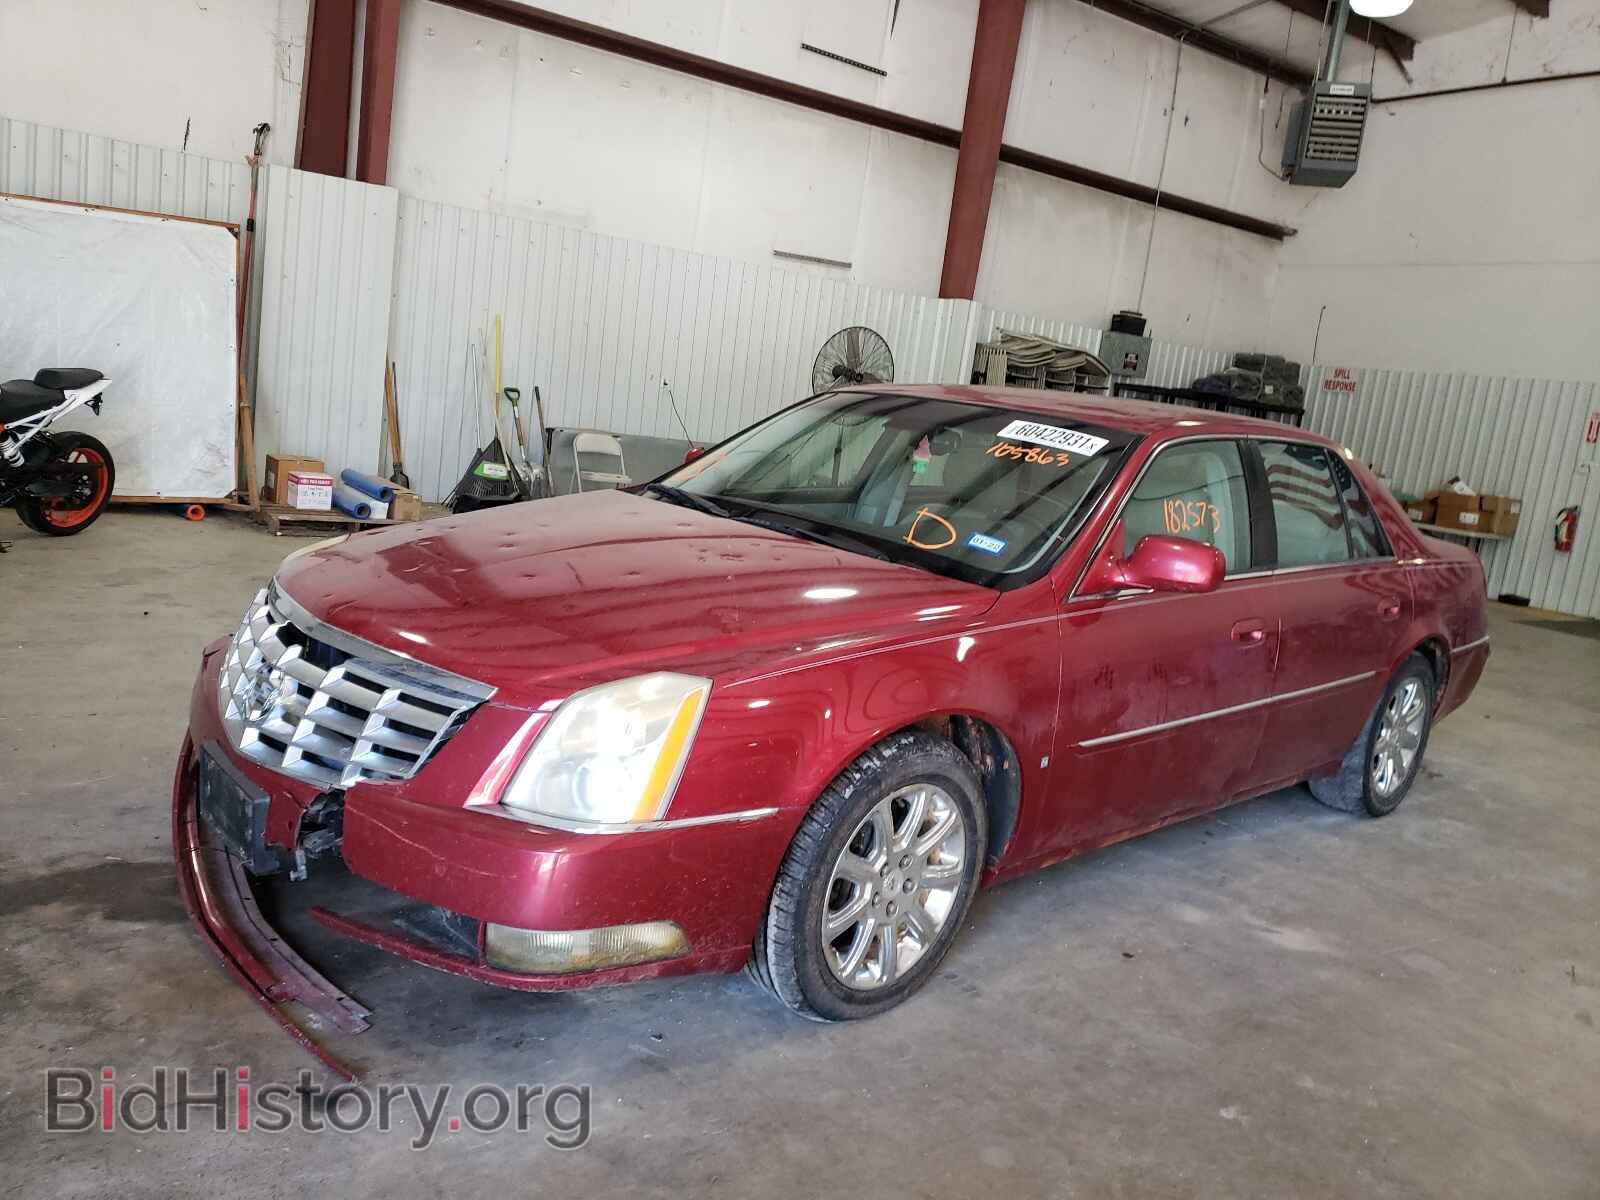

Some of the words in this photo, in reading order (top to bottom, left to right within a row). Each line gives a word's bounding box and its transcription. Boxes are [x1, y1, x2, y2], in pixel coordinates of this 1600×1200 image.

[1333, 367, 1350, 379] SPILL
[1322, 380, 1356, 391] RESPONSE
[1016, 424, 1092, 448] 60422931
[903, 508, 957, 550] D
